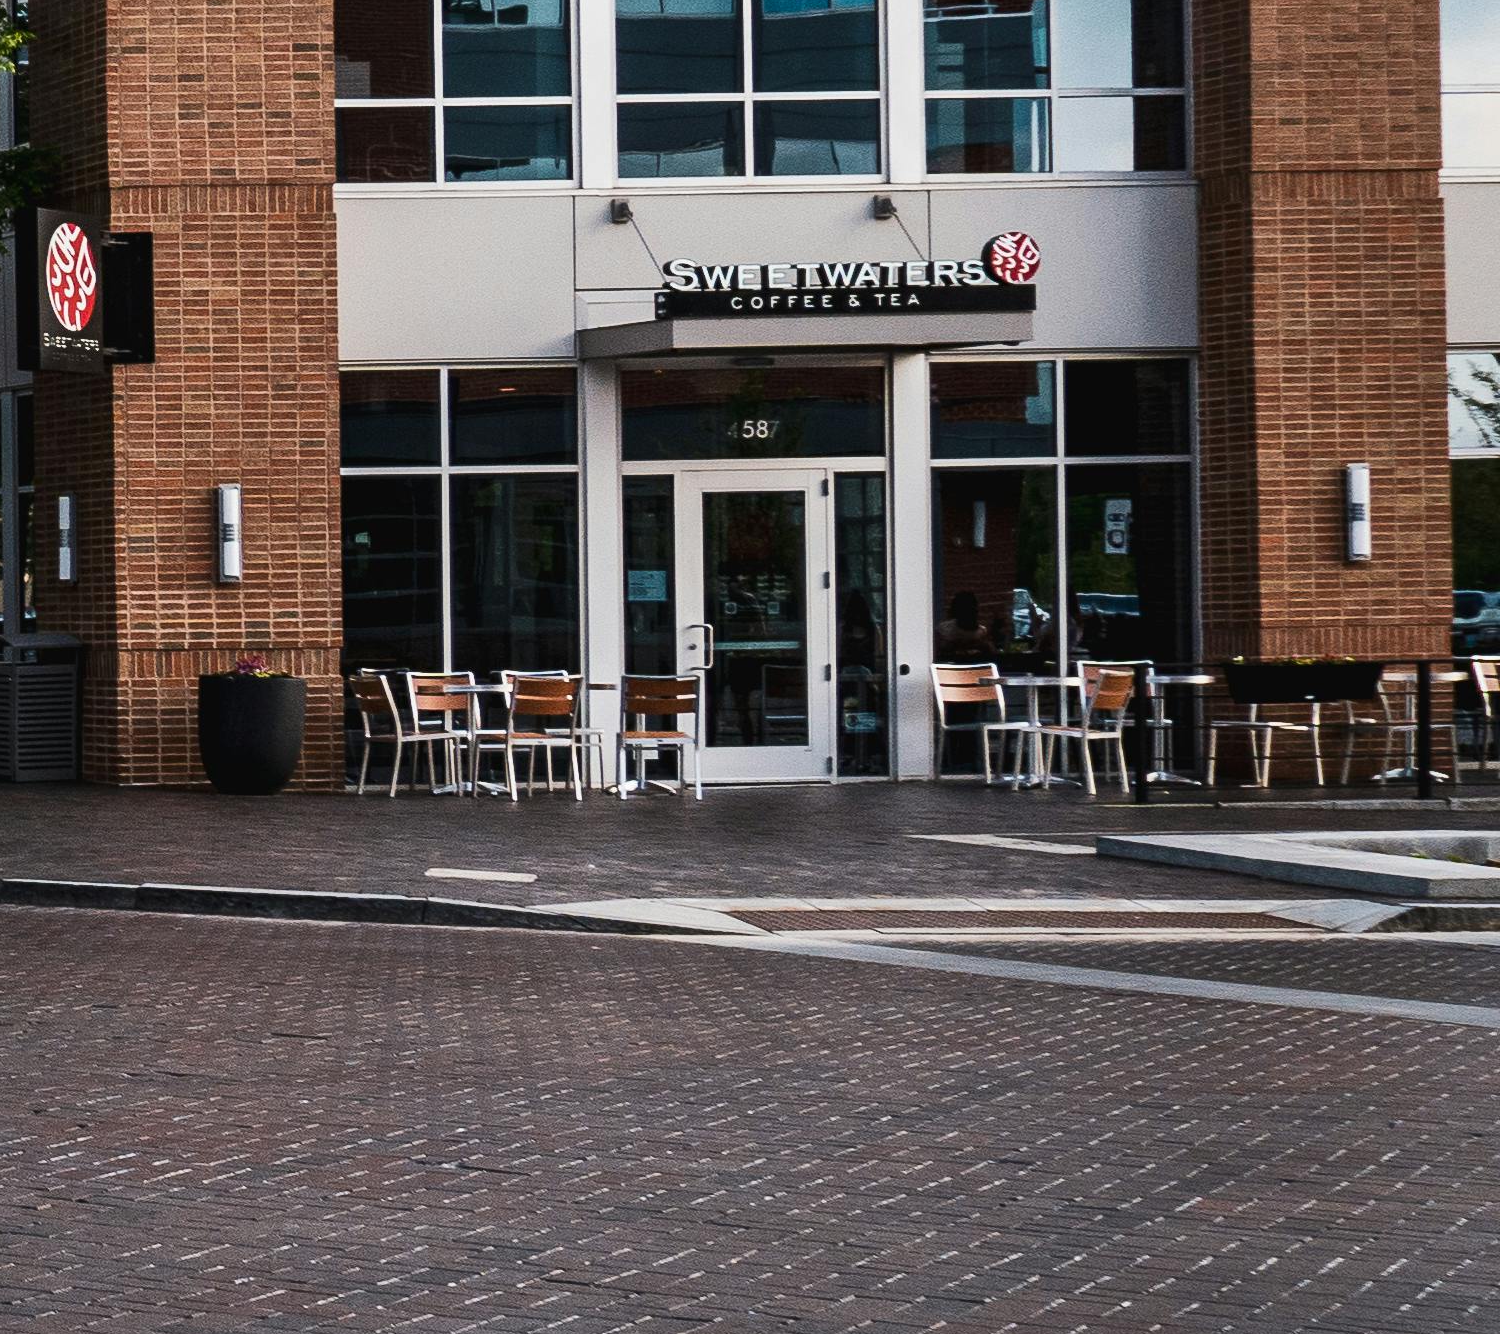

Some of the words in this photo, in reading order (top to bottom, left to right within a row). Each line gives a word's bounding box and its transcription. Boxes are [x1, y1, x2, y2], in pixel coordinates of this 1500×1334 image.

[668, 258, 988, 291] SWEETWATERS
[731, 295, 833, 310] COFFEE
[849, 294, 861, 307] &
[875, 293, 920, 306] TEA
